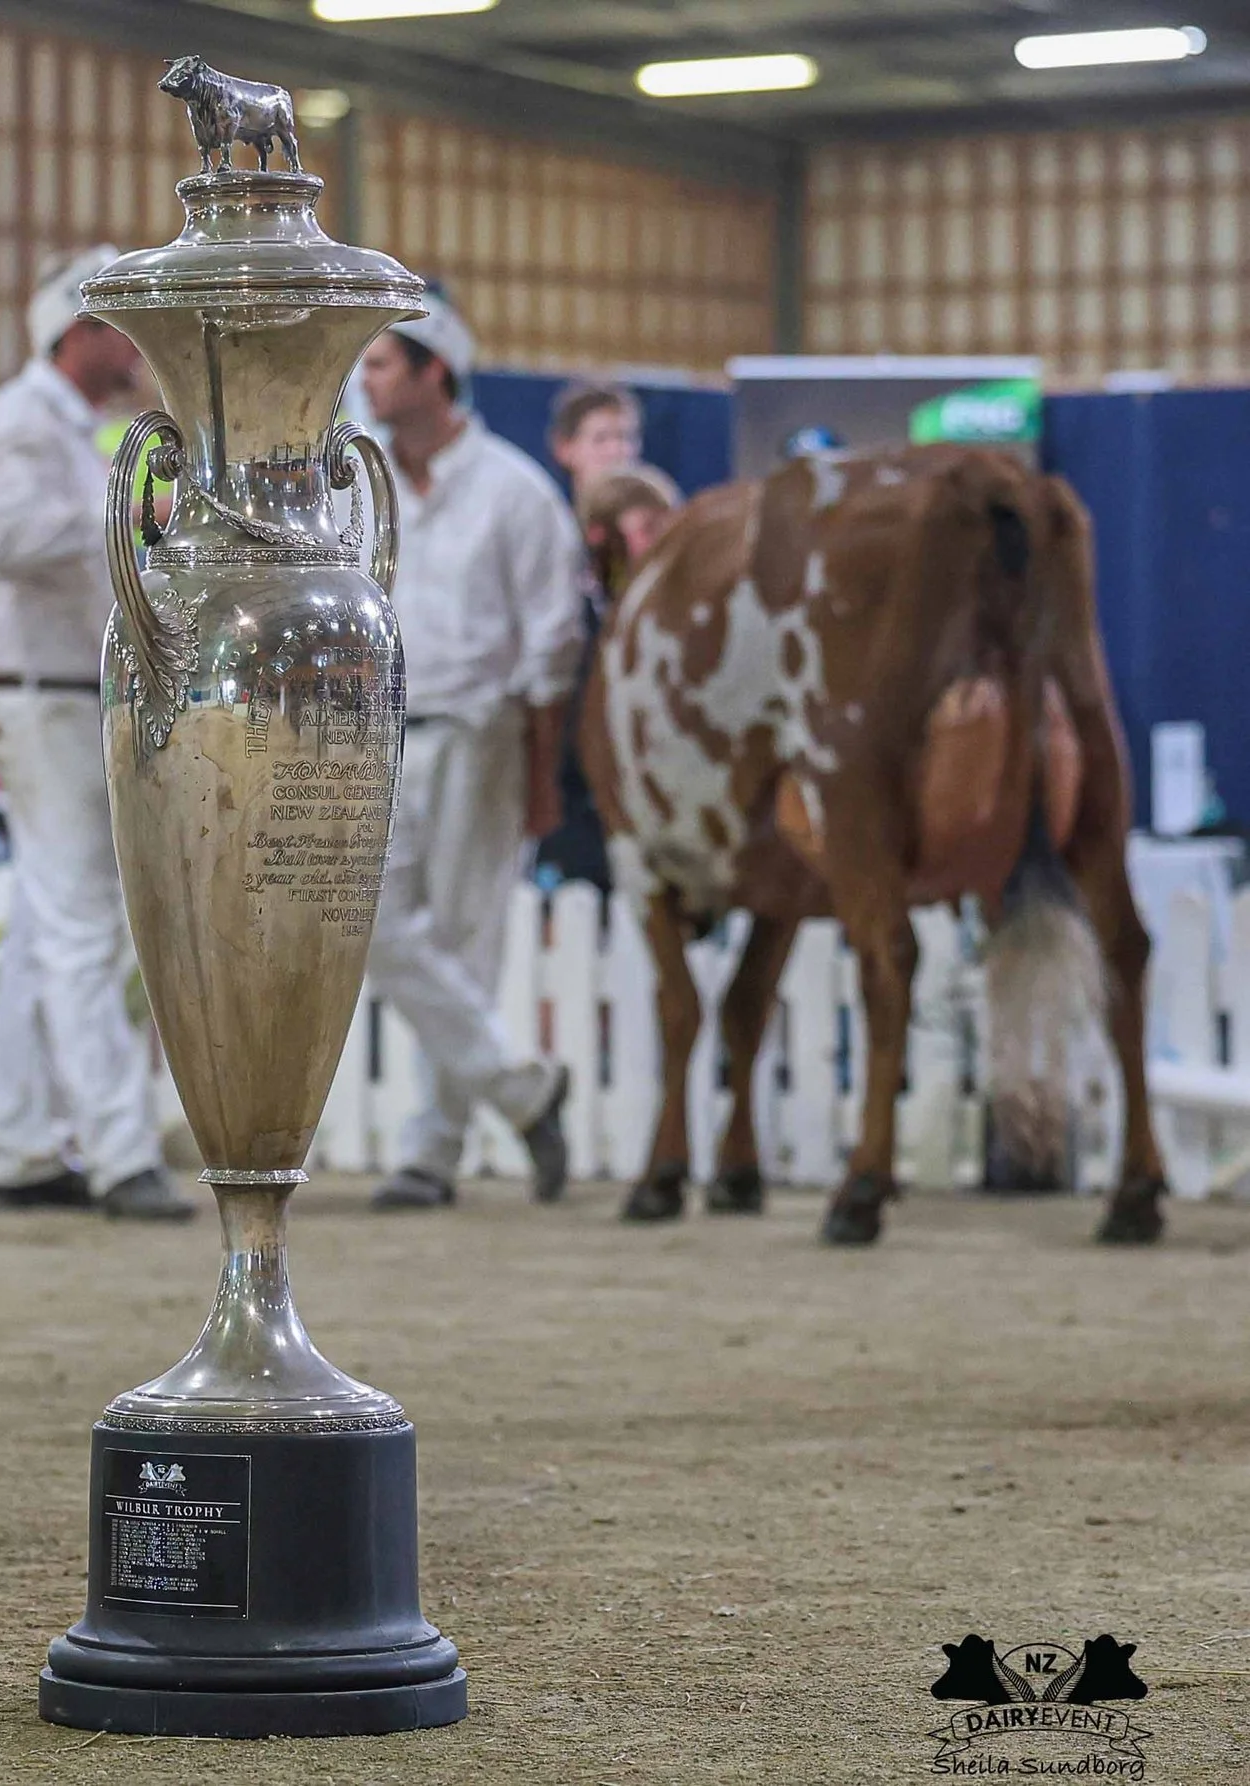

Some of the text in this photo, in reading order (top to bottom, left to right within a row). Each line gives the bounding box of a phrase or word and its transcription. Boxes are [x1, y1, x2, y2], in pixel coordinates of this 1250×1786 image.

[245, 704, 272, 758] THE
[321, 730, 359, 745] NEW
[366, 747, 379, 759] BY
[273, 785, 340, 800] CONSUL
[270, 804, 315, 820] NEW
[317, 804, 382, 820] ZEALAND
[357, 823, 375, 834] FOR
[288, 888, 337, 902] FIRST
[115, 1501, 224, 1518] WILBUR TROPHY
